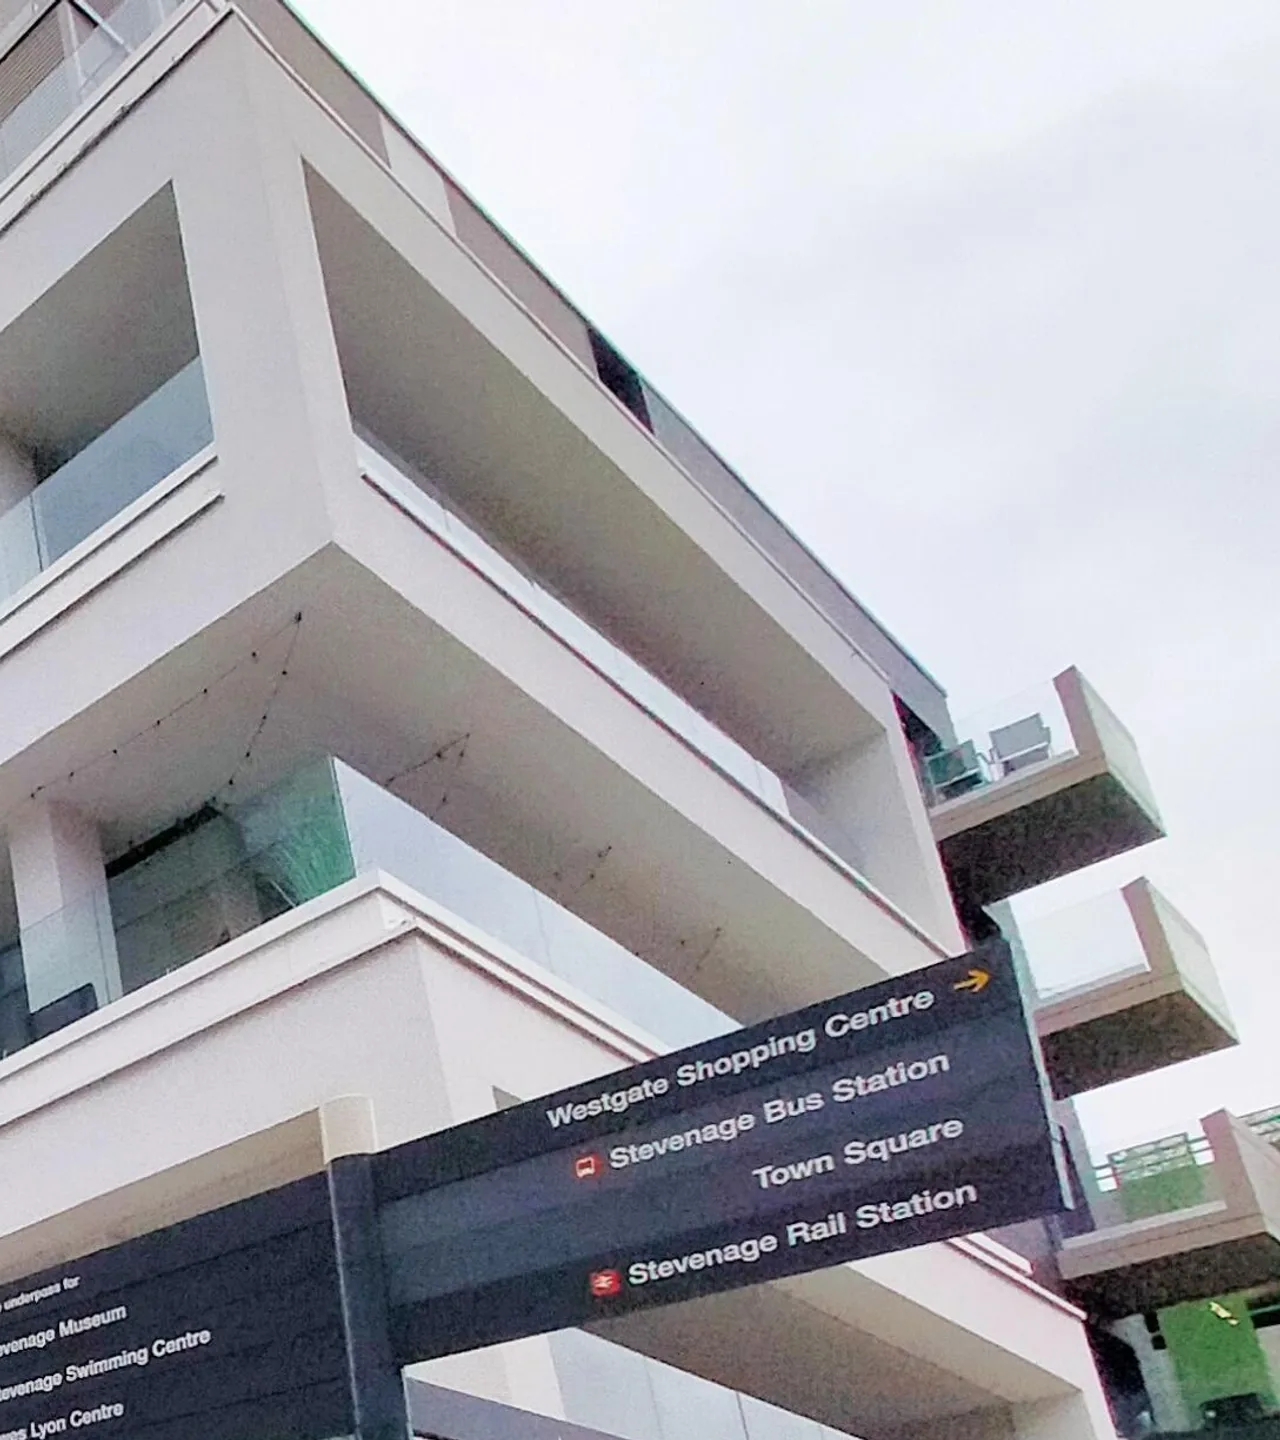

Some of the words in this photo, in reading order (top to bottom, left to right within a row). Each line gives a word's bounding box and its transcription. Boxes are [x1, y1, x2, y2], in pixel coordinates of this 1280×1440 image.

[546, 1076, 669, 1129] Westgate
[676, 1027, 817, 1087] Shopping
[824, 989, 936, 1039] Centre
[609, 1112, 755, 1170] Stevenage
[763, 1091, 825, 1124] Bus
[831, 1053, 951, 1103] Station
[752, 1153, 835, 1190] Town
[843, 1118, 964, 1165] Square
[628, 1234, 778, 1286] Stevenage
[786, 1212, 847, 1247] Rail
[855, 1183, 978, 1229] Station
[4, 1283, 61, 1310] underpass
[63, 1275, 81, 1290] for
[58, 1305, 127, 1338] Museum
[65, 1347, 148, 1383] Swimming
[152, 1328, 212, 1357] Centre
[30, 1416, 67, 1440] Lyon
[69, 1402, 124, 1428] Centre
